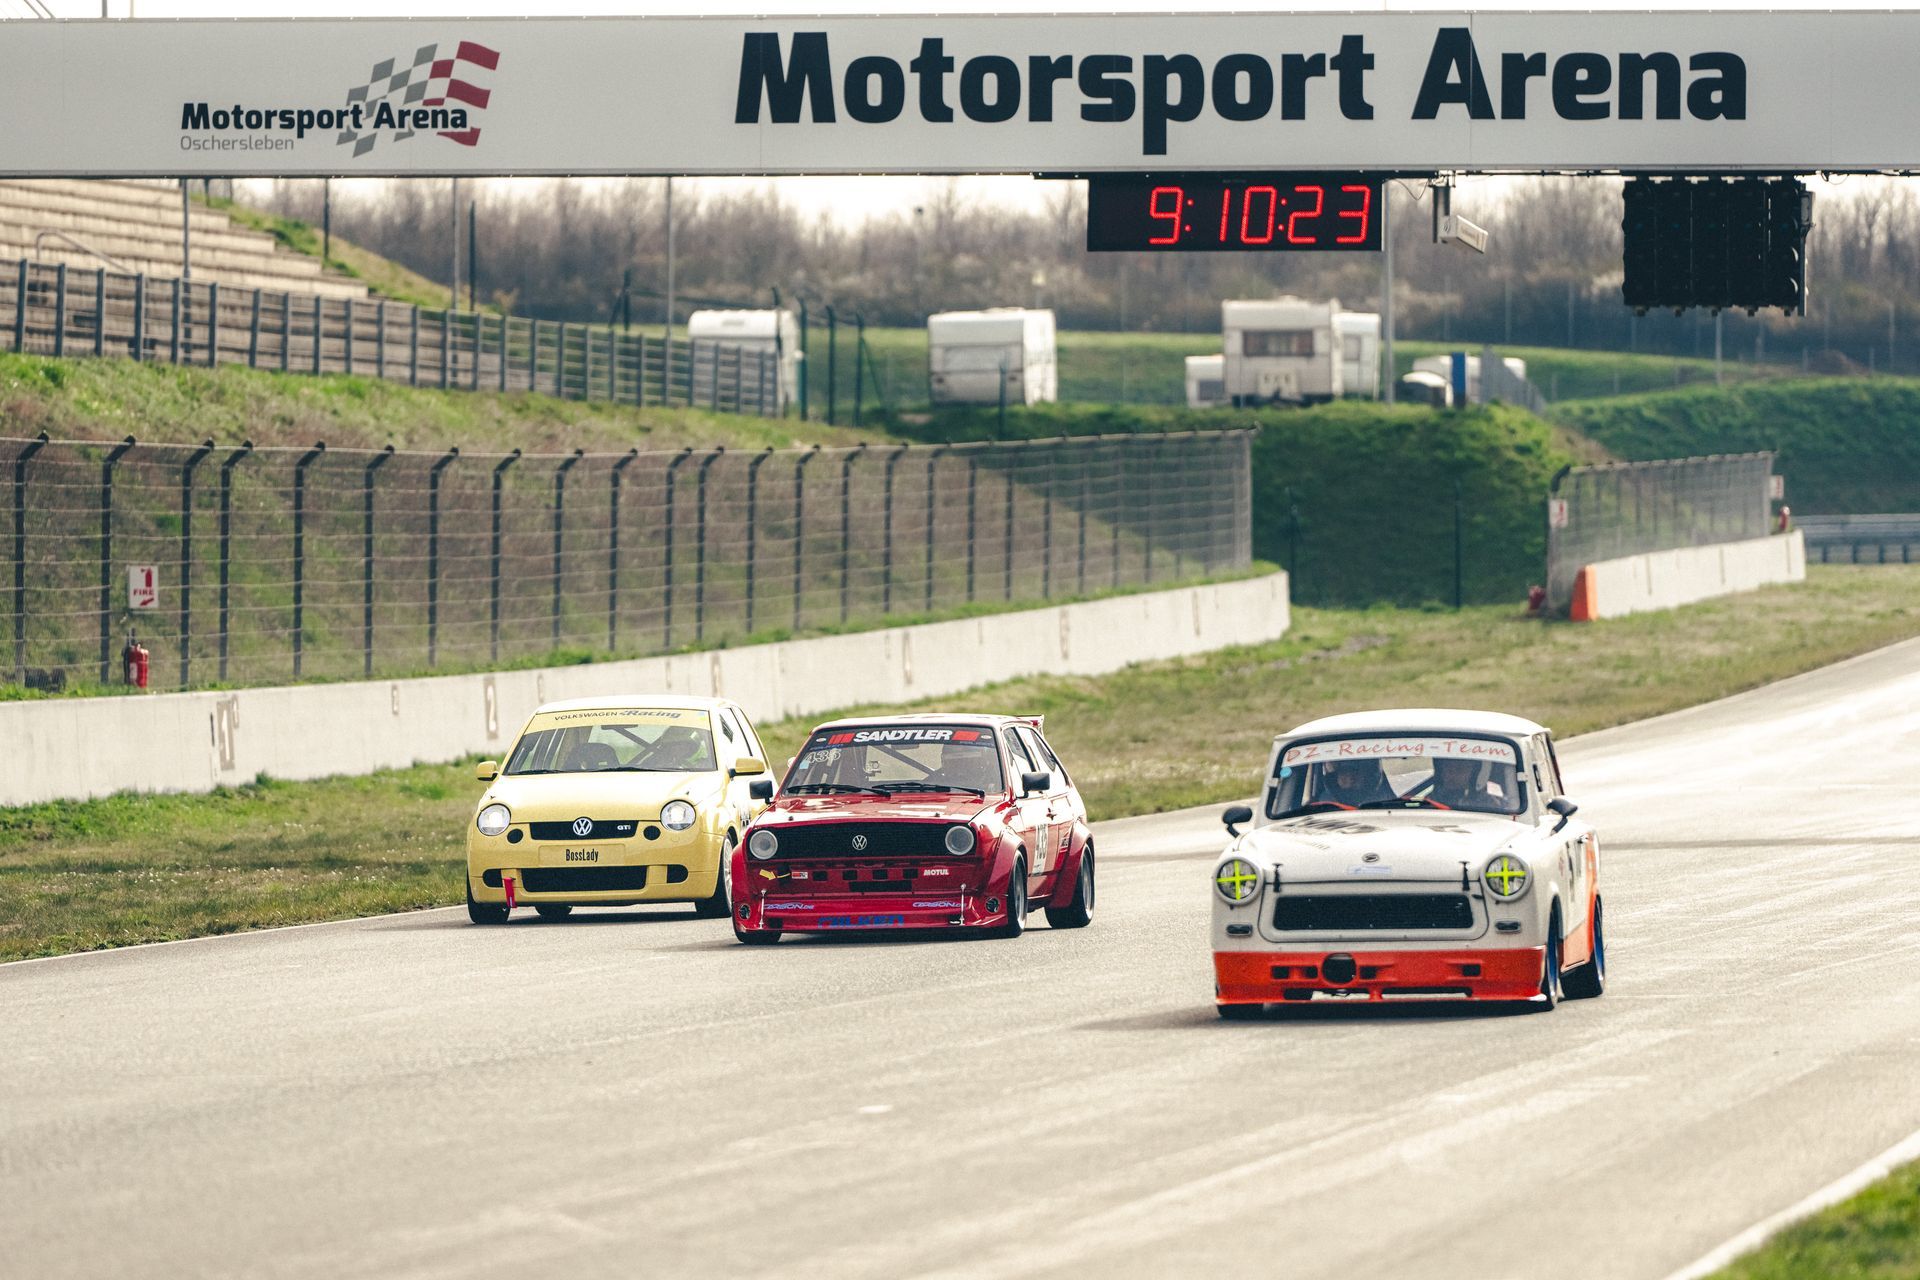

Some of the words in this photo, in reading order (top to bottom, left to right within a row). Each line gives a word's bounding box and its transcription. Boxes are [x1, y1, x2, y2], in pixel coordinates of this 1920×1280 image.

[734, 32, 1374, 155] Motorsport
[1411, 27, 1746, 120] Arena
[181, 103, 363, 138] Motorsport
[373, 102, 468, 129] Arena
[180, 134, 294, 151] Oschersleben
[1148, 185, 1371, 245] 9:10:23
[133, 588, 154, 596] FIRE
[554, 711, 618, 721] VOLKSWAGEN
[627, 710, 682, 719] Racing
[853, 729, 952, 742] SANDTLER
[565, 849, 599, 862] BossLady
